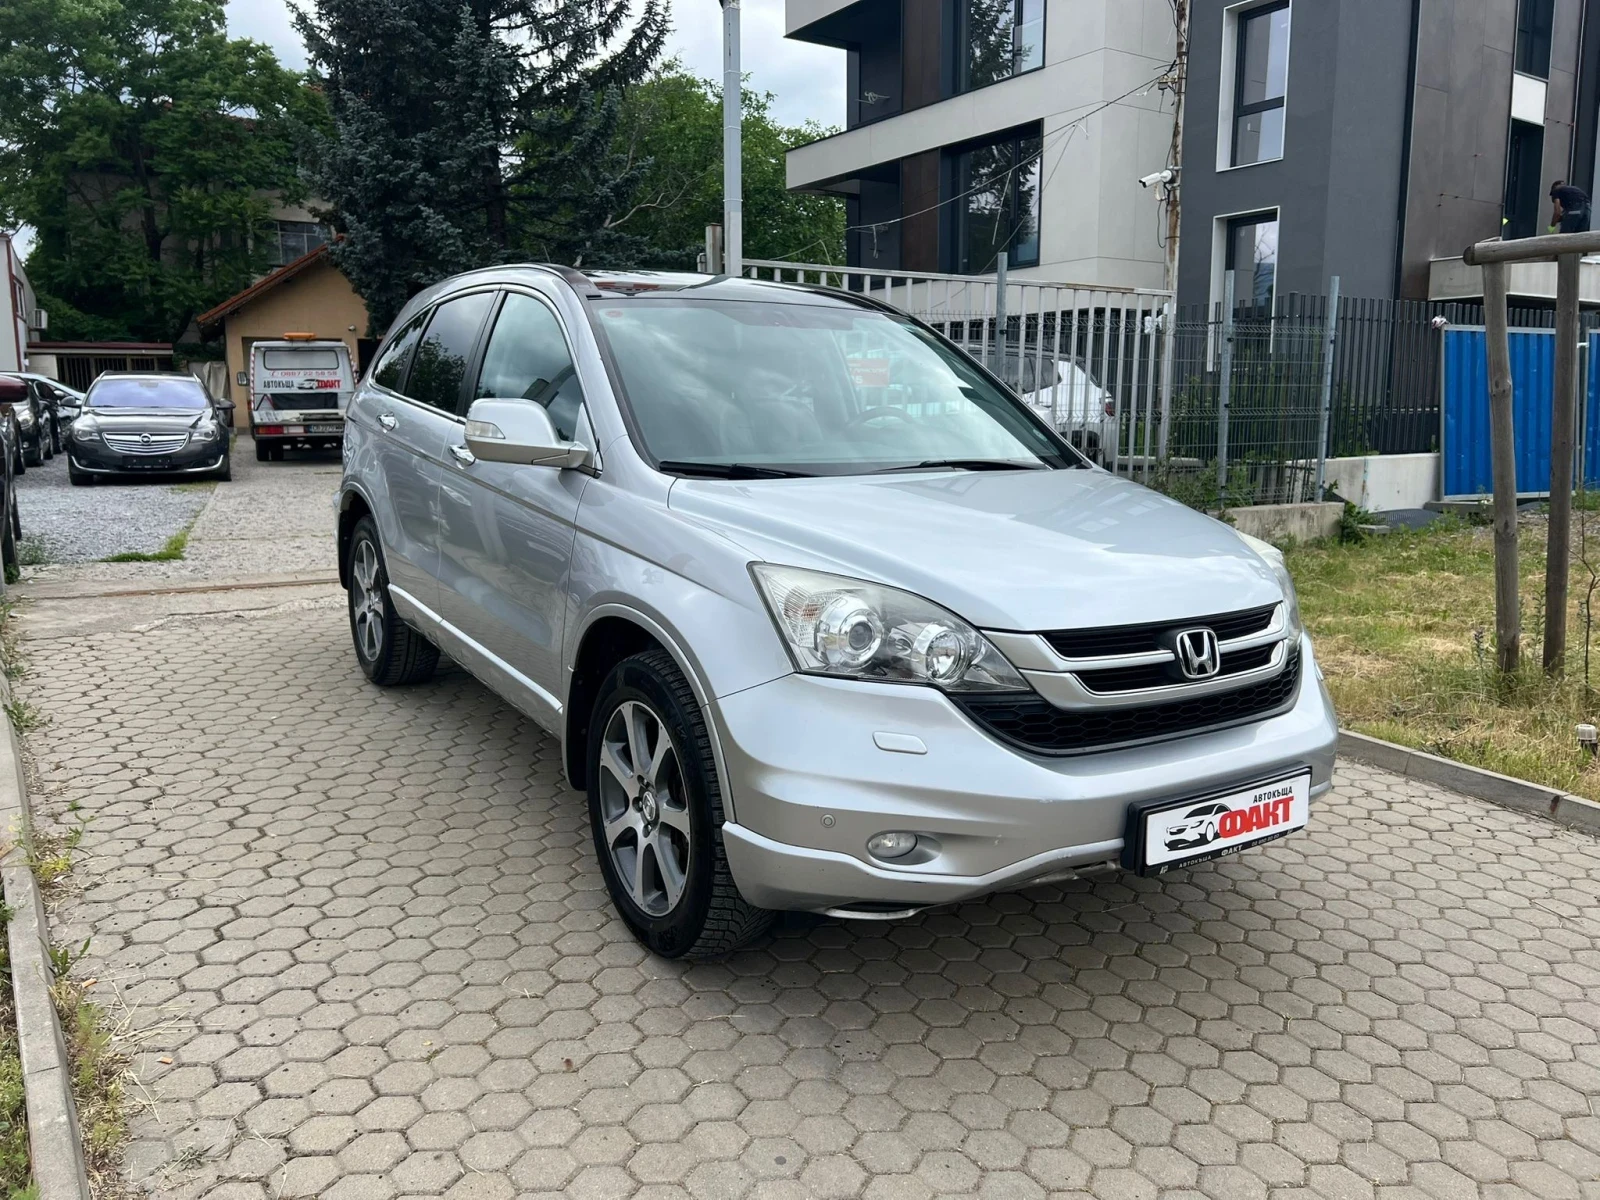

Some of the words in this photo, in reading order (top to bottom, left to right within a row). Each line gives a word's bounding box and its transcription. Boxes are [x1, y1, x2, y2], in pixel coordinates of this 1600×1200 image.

[1253, 786, 1293, 804] АВТОКЪЩА
[1219, 796, 1294, 838] ФАКТ
[1221, 845, 1243, 856] ФАКТ
